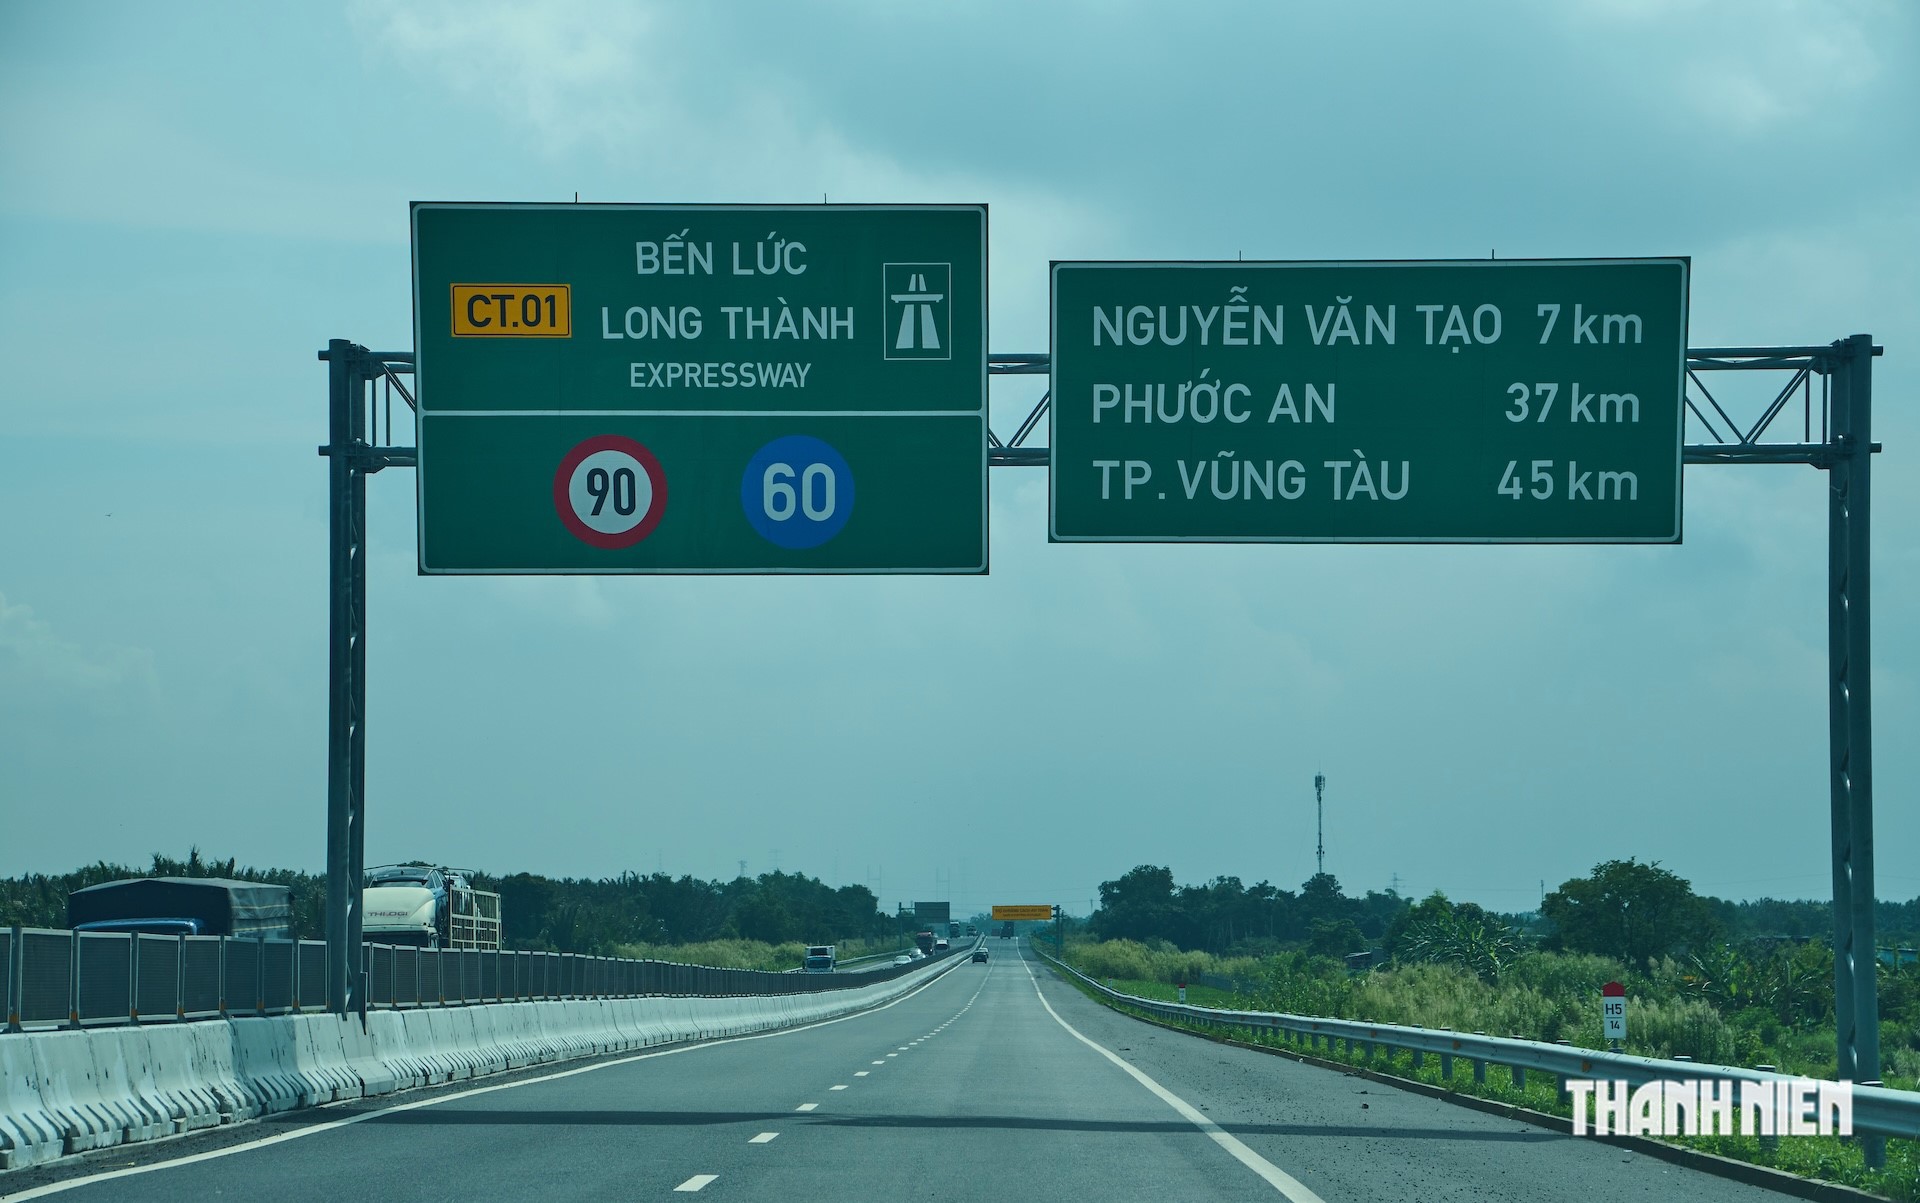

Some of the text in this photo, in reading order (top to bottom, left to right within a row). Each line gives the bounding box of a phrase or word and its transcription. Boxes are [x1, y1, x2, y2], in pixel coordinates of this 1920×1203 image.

[635, 228, 808, 276] BẾN LỨC
[467, 293, 557, 328] CT.01
[601, 296, 855, 340] LONG THÀNH
[1092, 285, 1643, 354] NGUYỄN VĂN TẠO 7 km
[630, 361, 812, 388] EXPRESSWAY
[1092, 367, 1640, 424] PHƯỚC AN 37 km
[585, 466, 636, 516] 90
[763, 462, 836, 522] 60
[1092, 448, 1638, 501] TP. VŨNG TÀU 45 km
[1605, 1003, 1622, 1015] H5
[1610, 1020, 1620, 1030] 14
